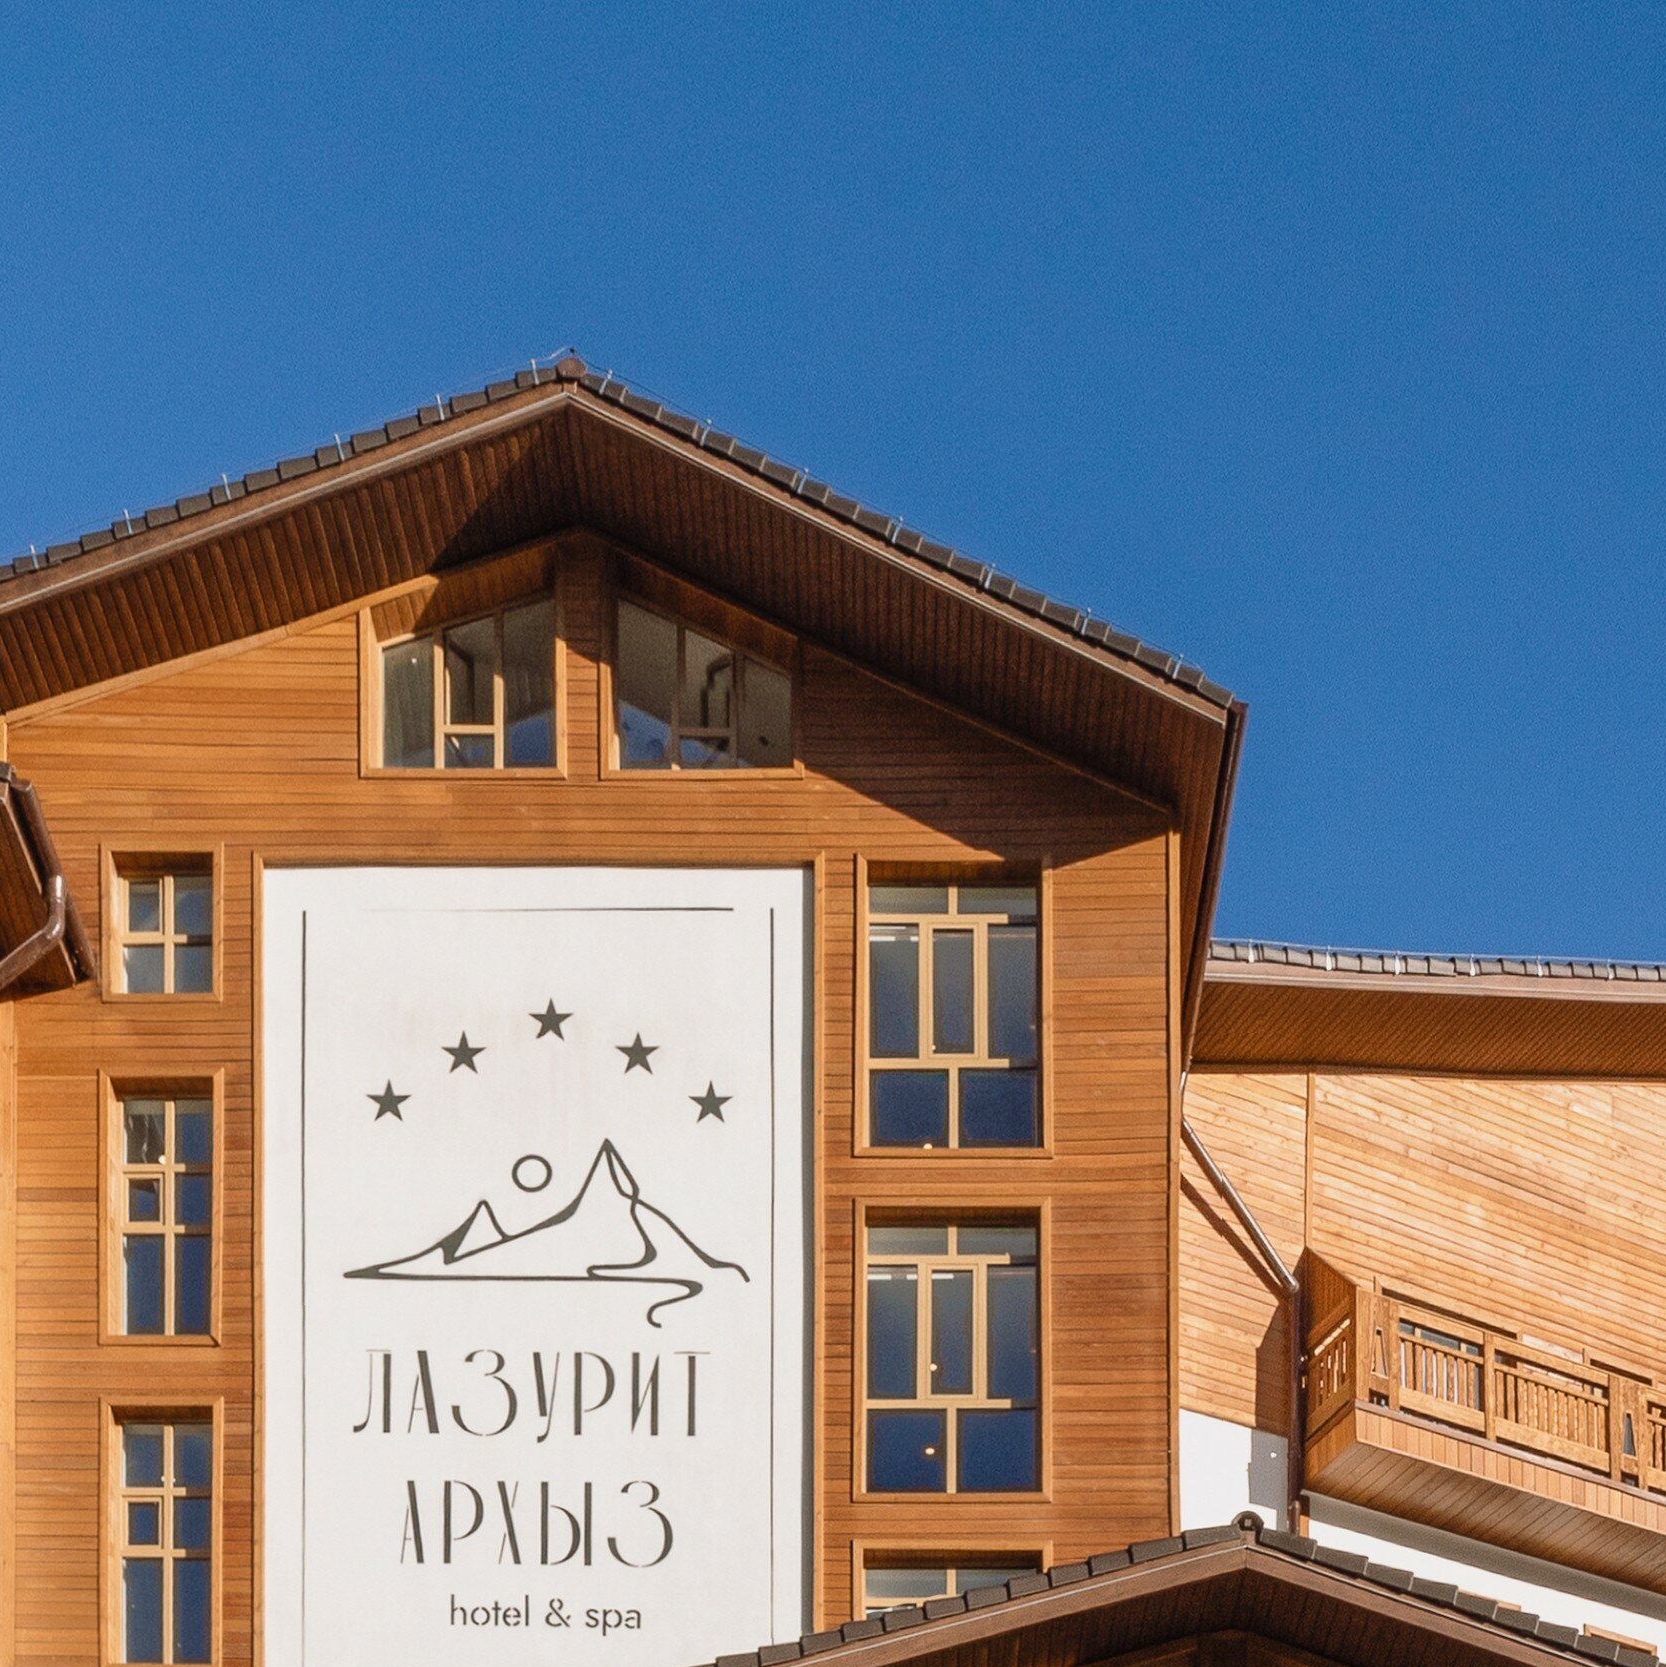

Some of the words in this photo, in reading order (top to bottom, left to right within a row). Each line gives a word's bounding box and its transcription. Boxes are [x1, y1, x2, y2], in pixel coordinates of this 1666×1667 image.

[352, 1348, 711, 1444] ЛАЗУРИТ
[399, 1479, 675, 1568] АРХЫЗ
[450, 1593, 530, 1627] hotel
[545, 1598, 572, 1628] &
[584, 1608, 642, 1637] spa
